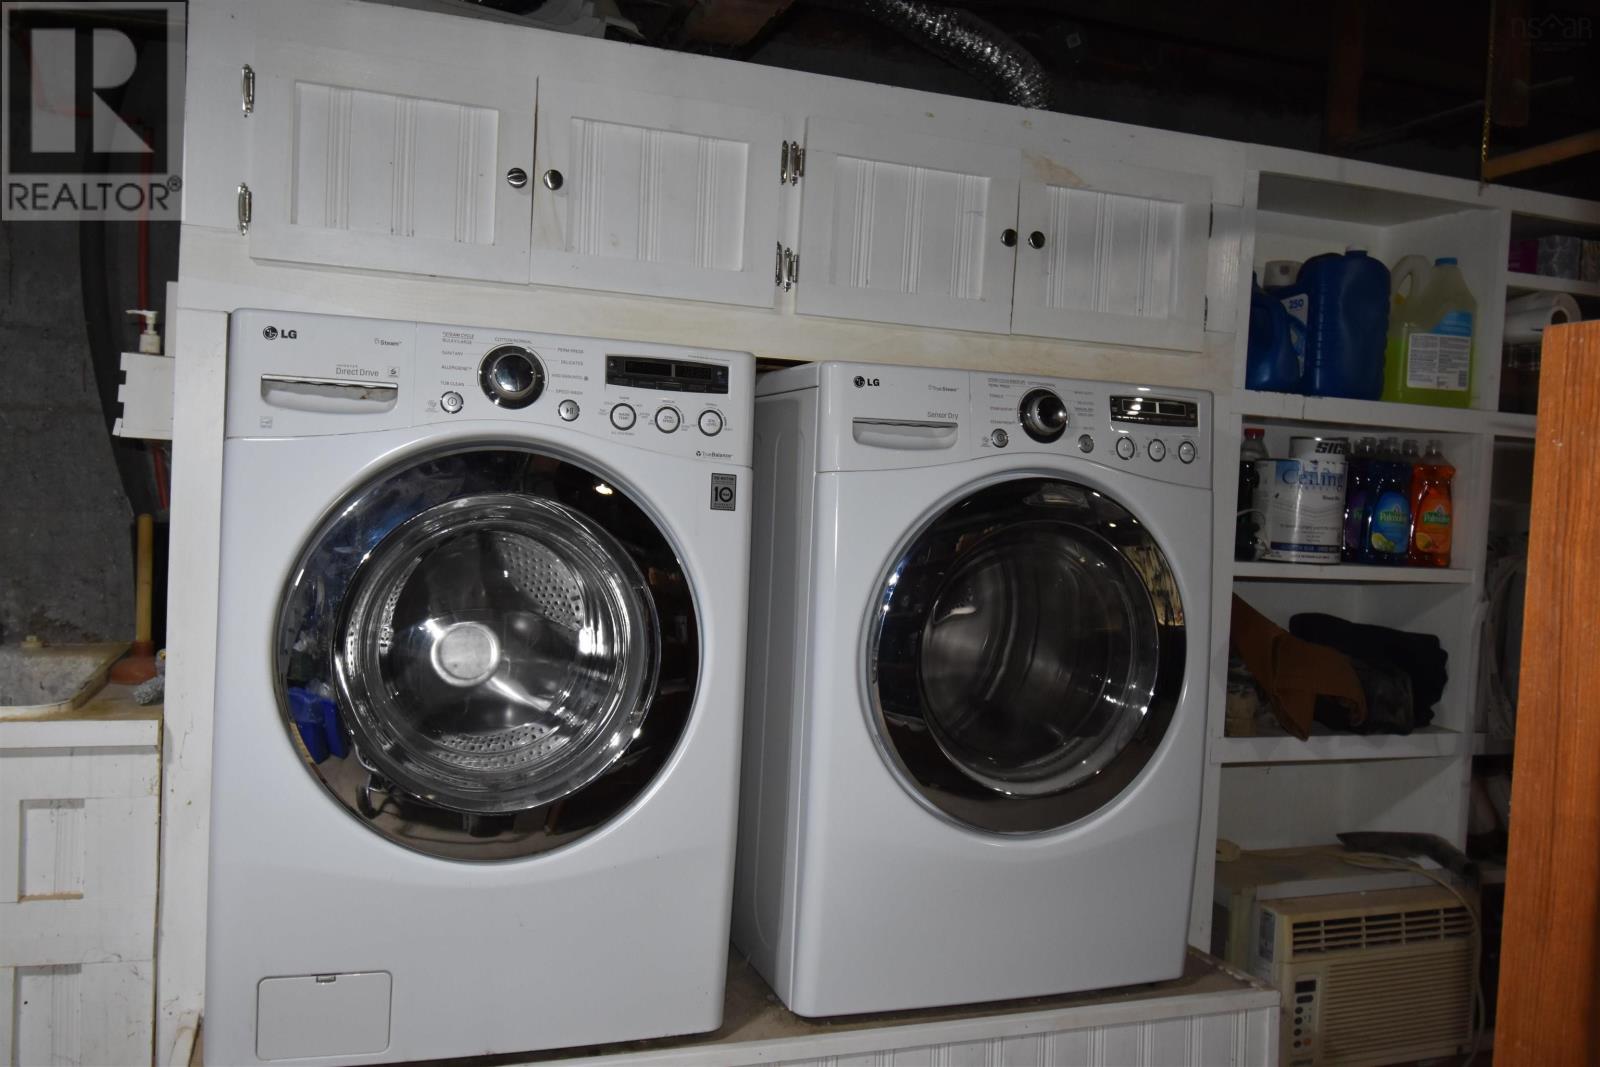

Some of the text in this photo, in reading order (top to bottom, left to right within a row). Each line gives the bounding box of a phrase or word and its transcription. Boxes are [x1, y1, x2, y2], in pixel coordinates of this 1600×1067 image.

[280, 329, 298, 340] LG
[336, 367, 379, 378] Direct Drive
[867, 378, 880, 387] LG
[927, 411, 959, 420] Sensor Dry
[1315, 442, 1346, 455] SIC
